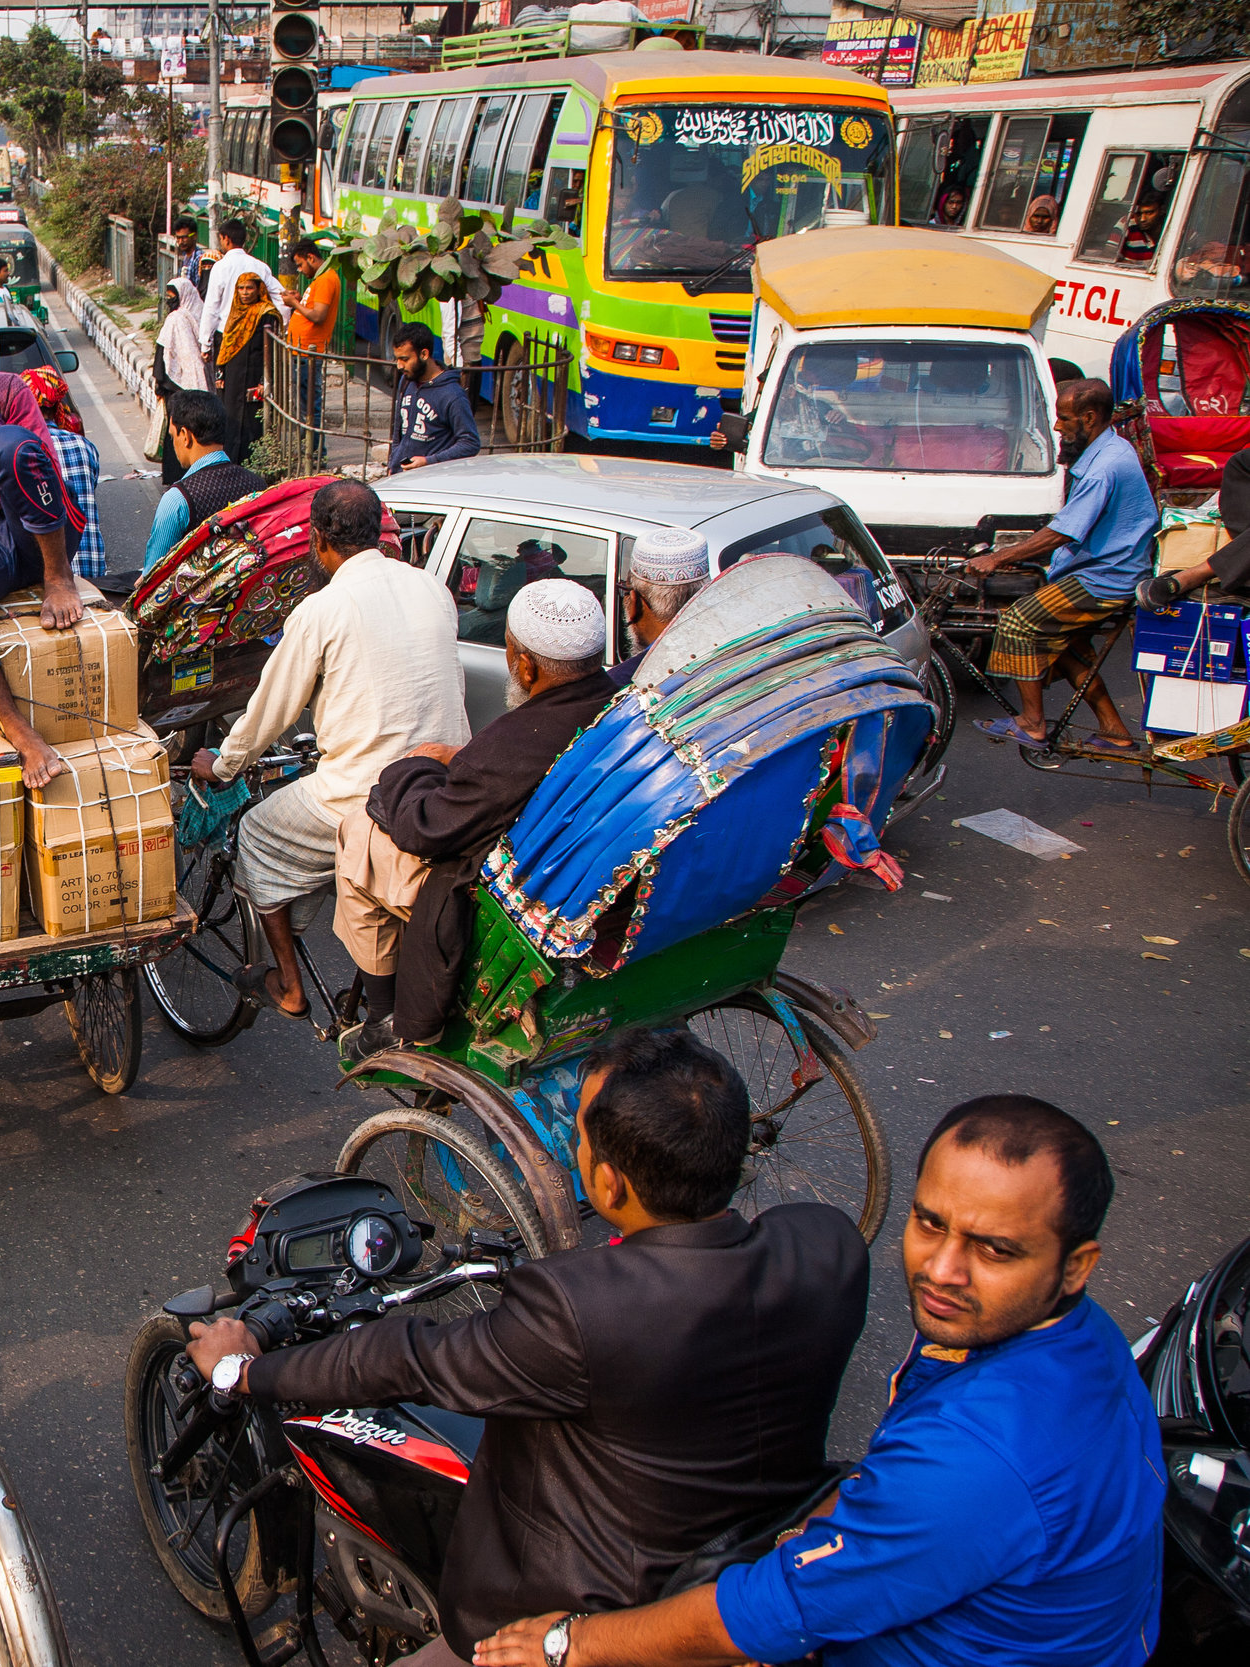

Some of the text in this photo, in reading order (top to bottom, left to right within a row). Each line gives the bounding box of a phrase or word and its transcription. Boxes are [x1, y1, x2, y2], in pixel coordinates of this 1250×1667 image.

[923, 27, 963, 60] SONIA
[58, 701, 78, 709] GROSS
[52, 853, 68, 861] RED
[90, 847, 104, 855] 707
[60, 877, 82, 888] ART
[61, 880, 139, 901] QTY 6 GROSS
